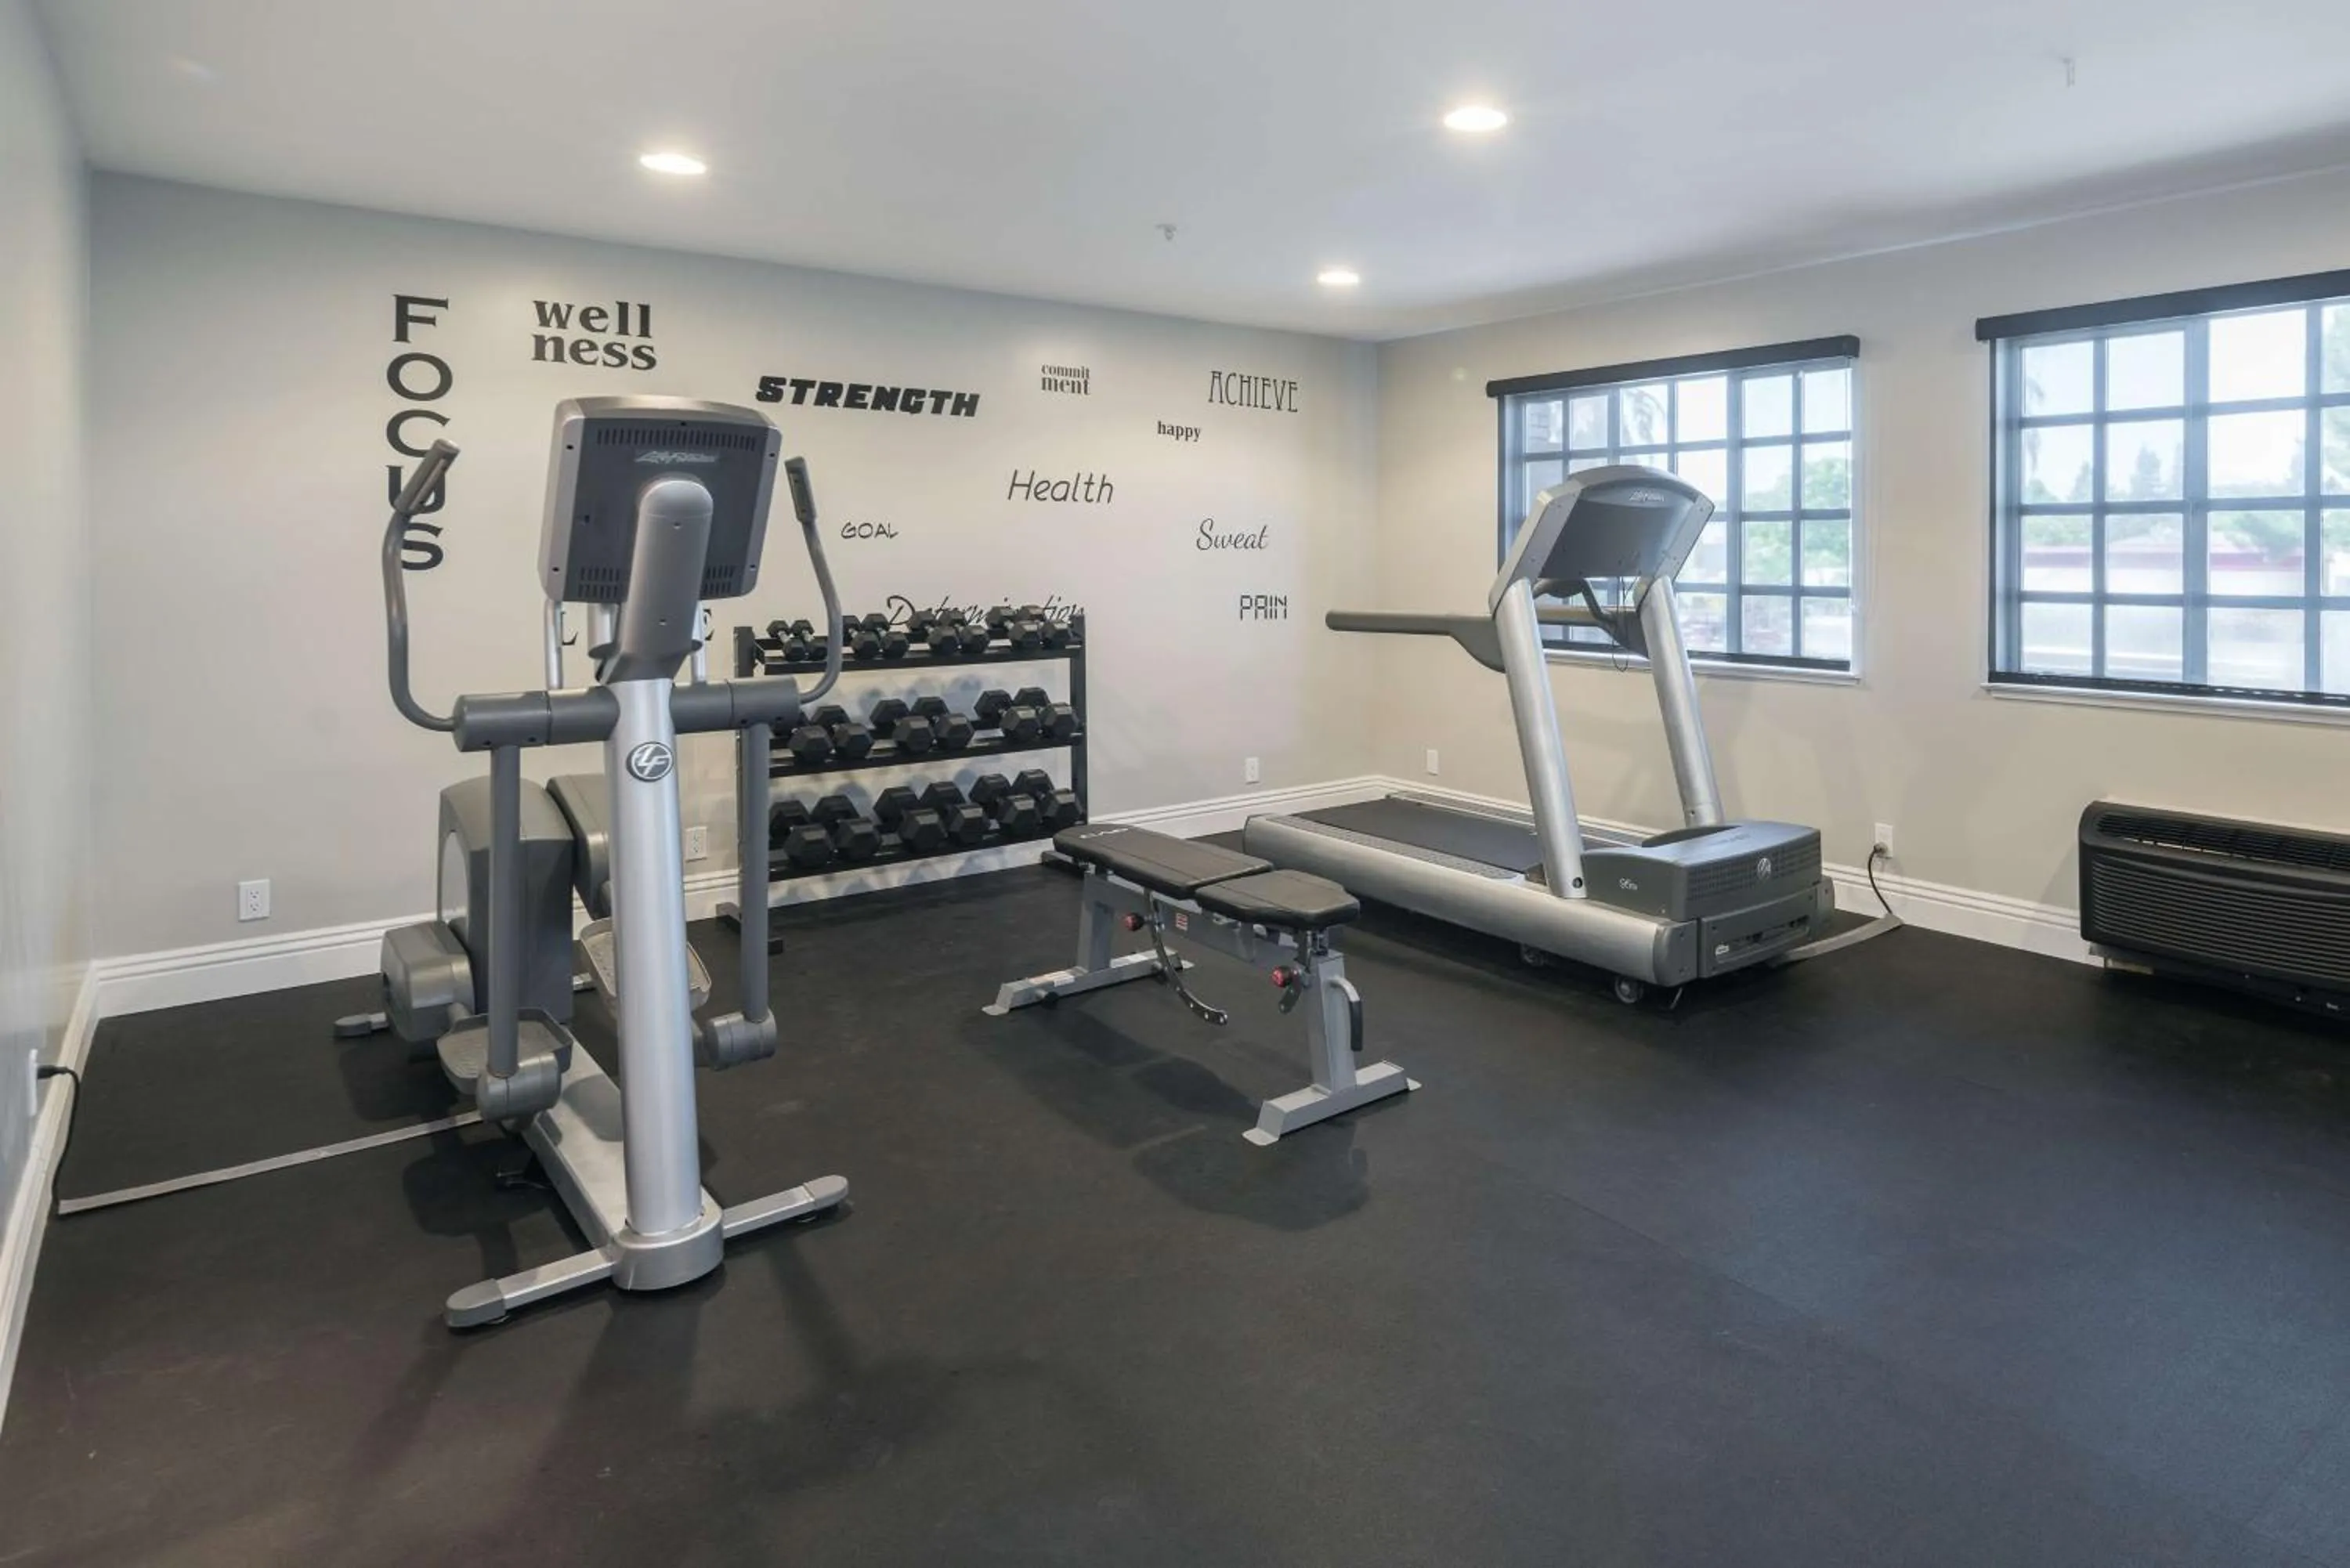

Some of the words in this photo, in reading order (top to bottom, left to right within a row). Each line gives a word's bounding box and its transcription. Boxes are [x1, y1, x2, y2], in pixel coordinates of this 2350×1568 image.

[533, 300, 653, 338] well
[532, 333, 657, 370] ness
[1041, 364, 1090, 379] commit
[1041, 377, 1090, 395] ment
[756, 375, 980, 417] STRENGTH
[1209, 370, 1298, 413] ACHIEVE
[385, 294, 454, 571] FOCUS
[1157, 420, 1201, 442] happy
[1007, 469, 1114, 504] Health
[841, 522, 899, 539] GOAL
[1196, 518, 1269, 551] Sweat
[1240, 594, 1287, 620] PAIN
